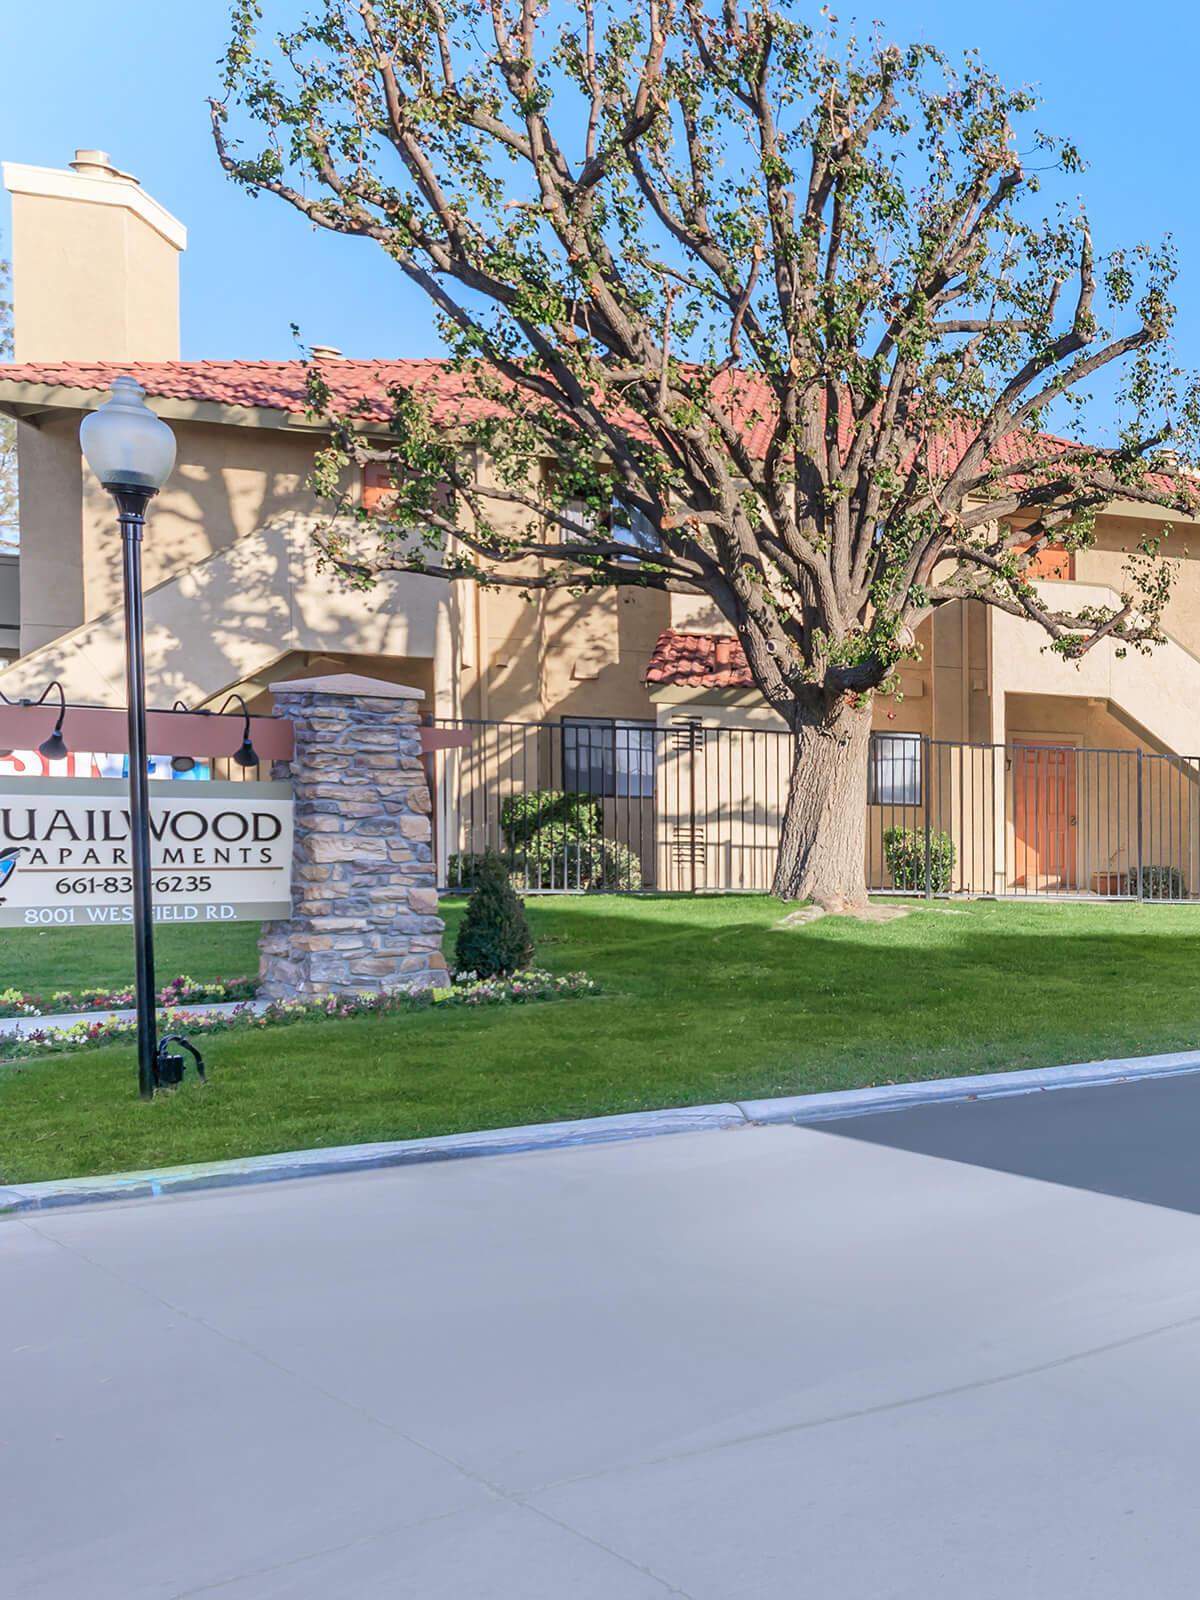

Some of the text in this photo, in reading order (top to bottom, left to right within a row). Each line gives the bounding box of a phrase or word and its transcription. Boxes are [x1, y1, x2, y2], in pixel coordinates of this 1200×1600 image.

[0, 808, 282, 842] UAILWOOD
[29, 847, 272, 865] APARMENTS
[56, 876, 212, 894] 661-83-6235
[24, 907, 75, 924] 8001
[206, 905, 237, 920] RD.
